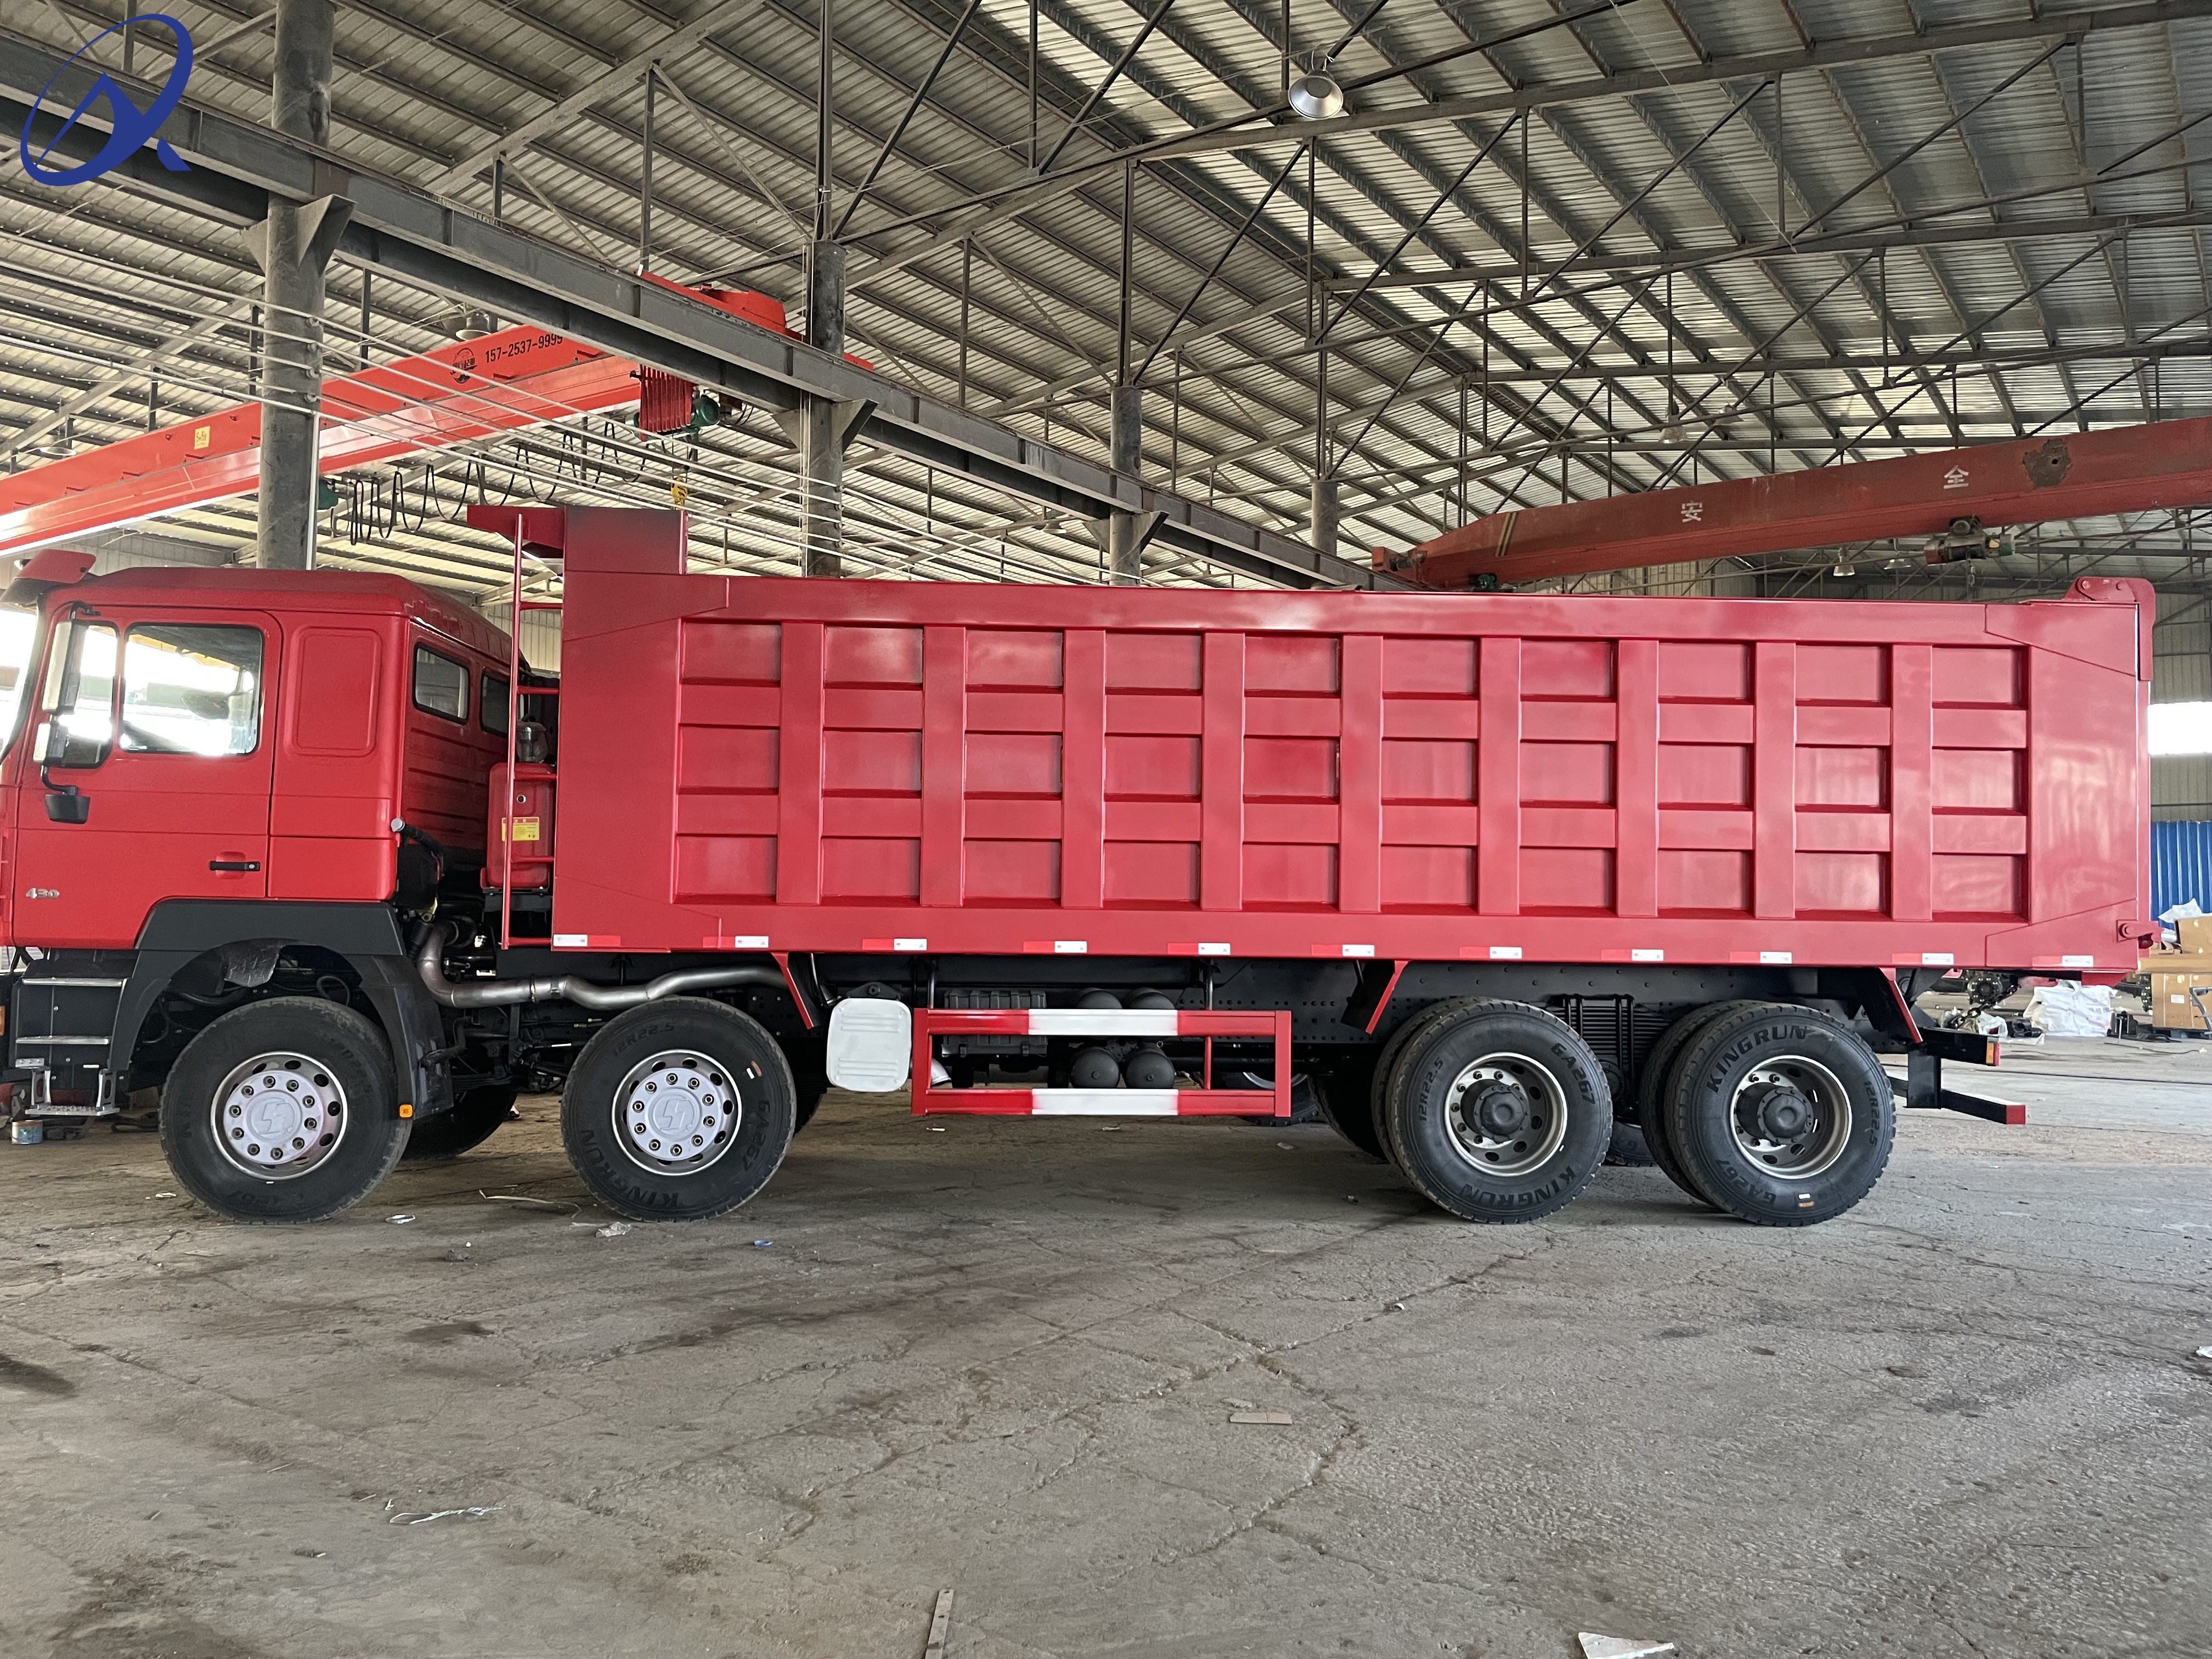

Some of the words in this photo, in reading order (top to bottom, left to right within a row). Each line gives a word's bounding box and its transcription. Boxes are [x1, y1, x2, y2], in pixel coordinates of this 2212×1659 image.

[1680, 500, 1704, 523] 安
[1943, 465, 1970, 490] 全
[25, 887, 60, 900] 430
[1550, 1042, 1595, 1105] GA267
[1706, 1024, 1808, 1093] KINGRUN
[1418, 1056, 1444, 1122] 12R22.5
[579, 1128, 679, 1207] KINGRUN
[1459, 1165, 1577, 1206] KINGRUN
[1715, 1159, 1777, 1205] GA267
